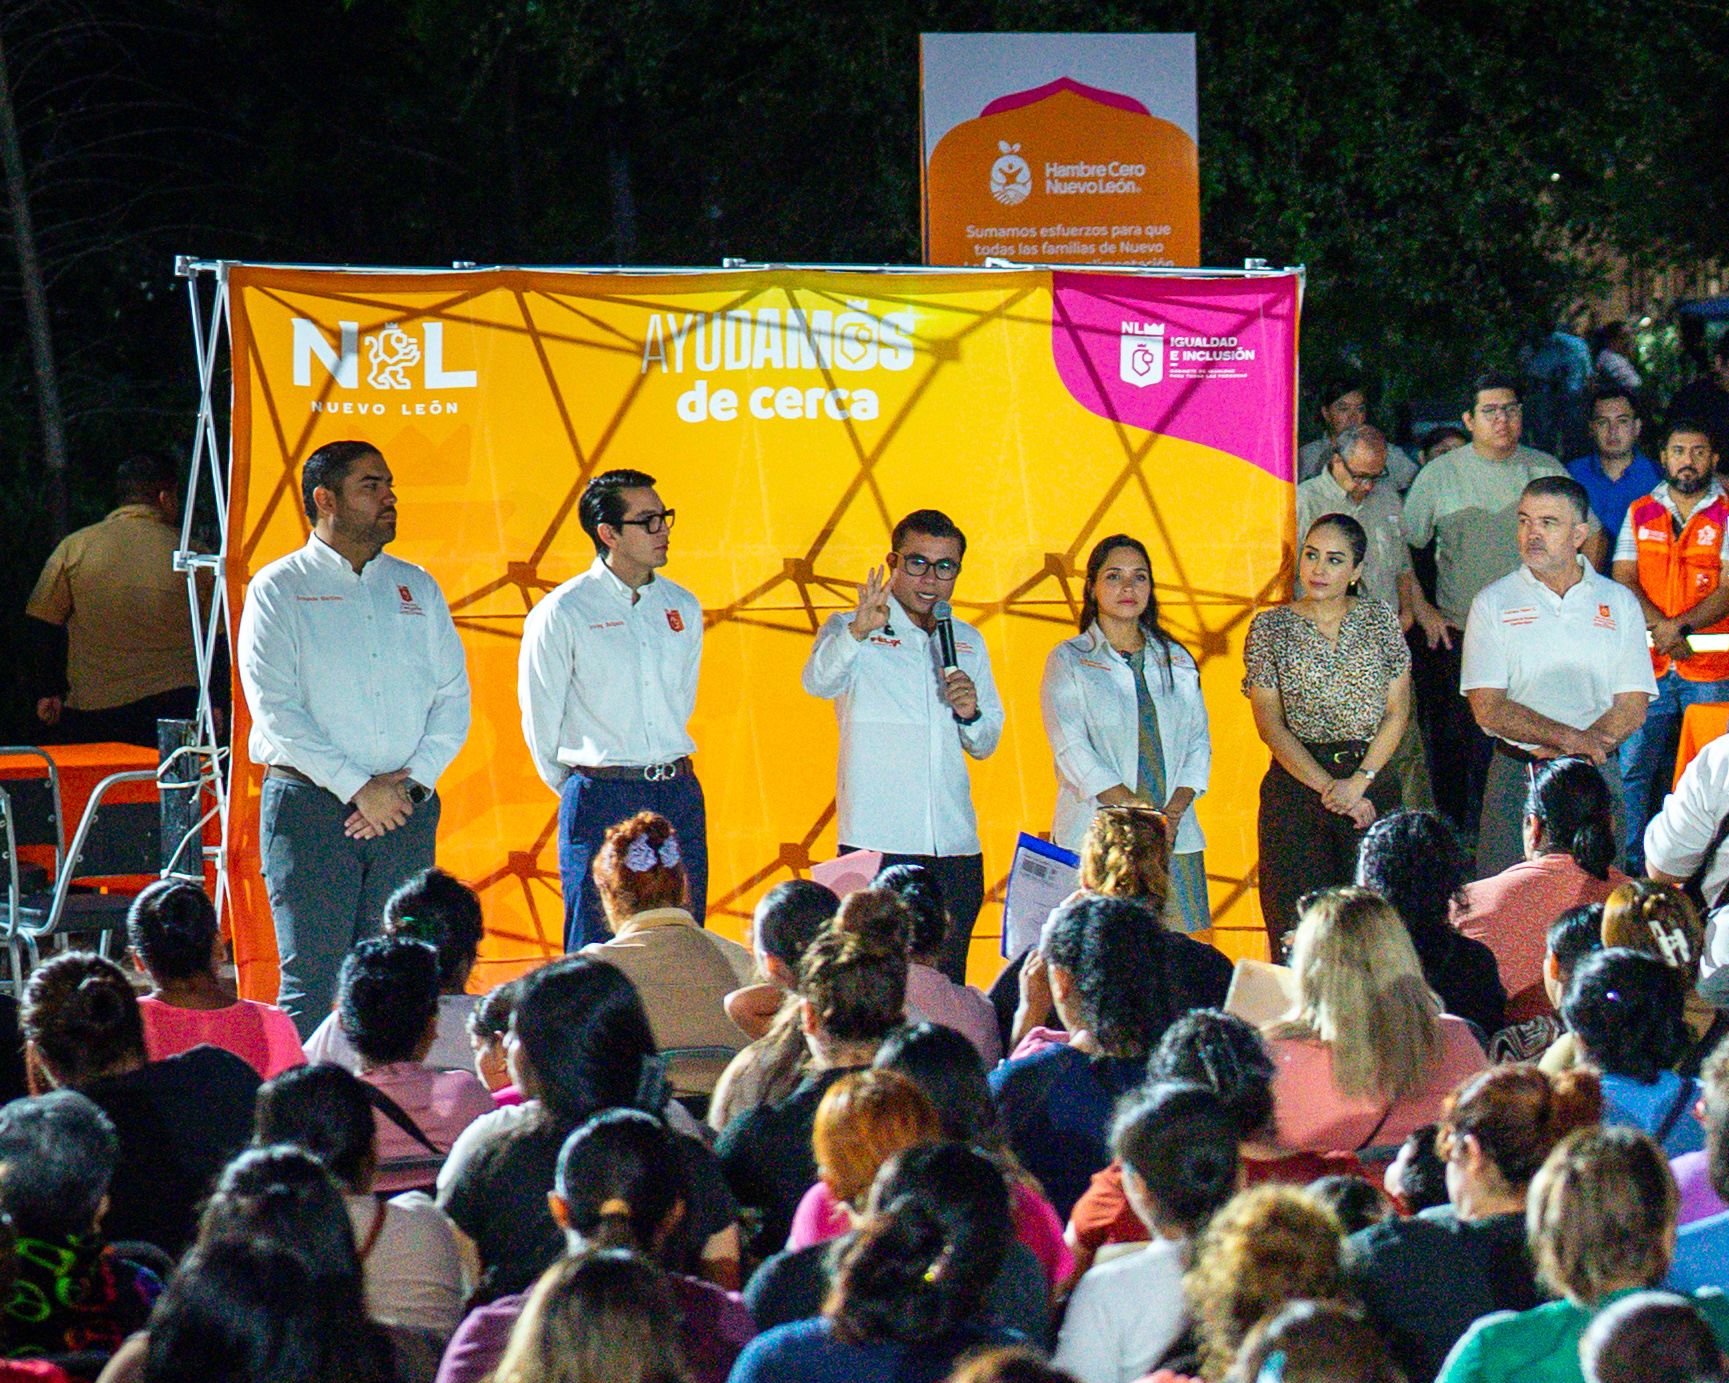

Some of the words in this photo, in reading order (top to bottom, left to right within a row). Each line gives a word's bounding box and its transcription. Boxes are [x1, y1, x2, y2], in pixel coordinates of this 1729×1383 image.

[1045, 161, 1107, 177] Hambre
[1108, 161, 1146, 177] Cero
[1045, 179, 1097, 194] Nuevo
[966, 225, 1037, 238] Sumamos
[1040, 224, 1107, 237] esfuerzos
[1112, 225, 1141, 239] para
[1145, 224, 1171, 238] que
[974, 243, 1015, 256] todas
[1019, 242, 1038, 255] las
[1042, 241, 1095, 254] familias
[1099, 241, 1116, 253] de
[1120, 241, 1164, 253] Nuevo
[641, 307, 915, 374] AYUDAMOS
[1170, 337, 1238, 348] IGUALDAD
[1170, 350, 1179, 360] E
[1183, 347, 1255, 361] INCLUSIÓN
[311, 401, 386, 415] NUEVO
[402, 400, 459, 415] LEÓN
[676, 380, 738, 422] de
[749, 386, 879, 421] cerca
